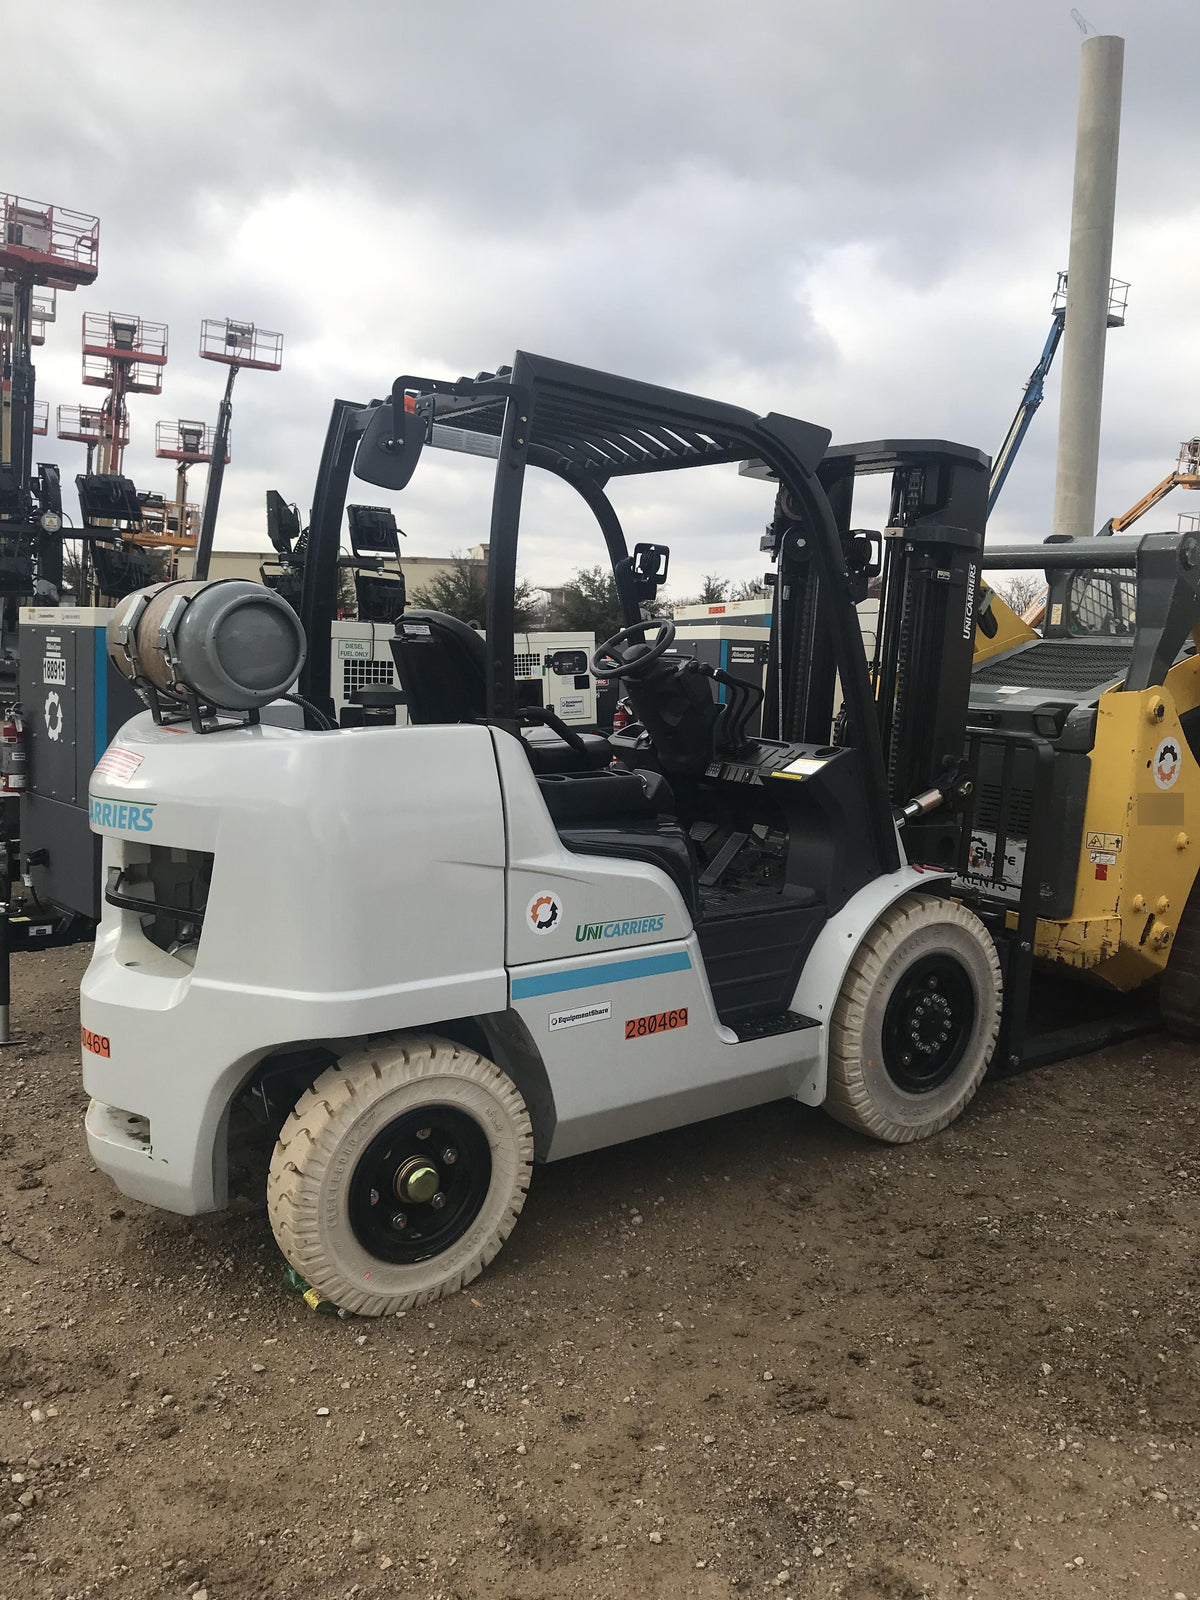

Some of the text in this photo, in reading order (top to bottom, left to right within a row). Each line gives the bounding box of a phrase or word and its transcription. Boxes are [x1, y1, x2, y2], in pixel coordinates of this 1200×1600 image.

[963, 562, 977, 640] UNICARRIERS
[44, 660, 66, 681] 188915
[575, 916, 665, 943] UNICARRIERS
[558, 1007, 609, 1025] EquipmentShare
[626, 1008, 688, 1039] 280469
